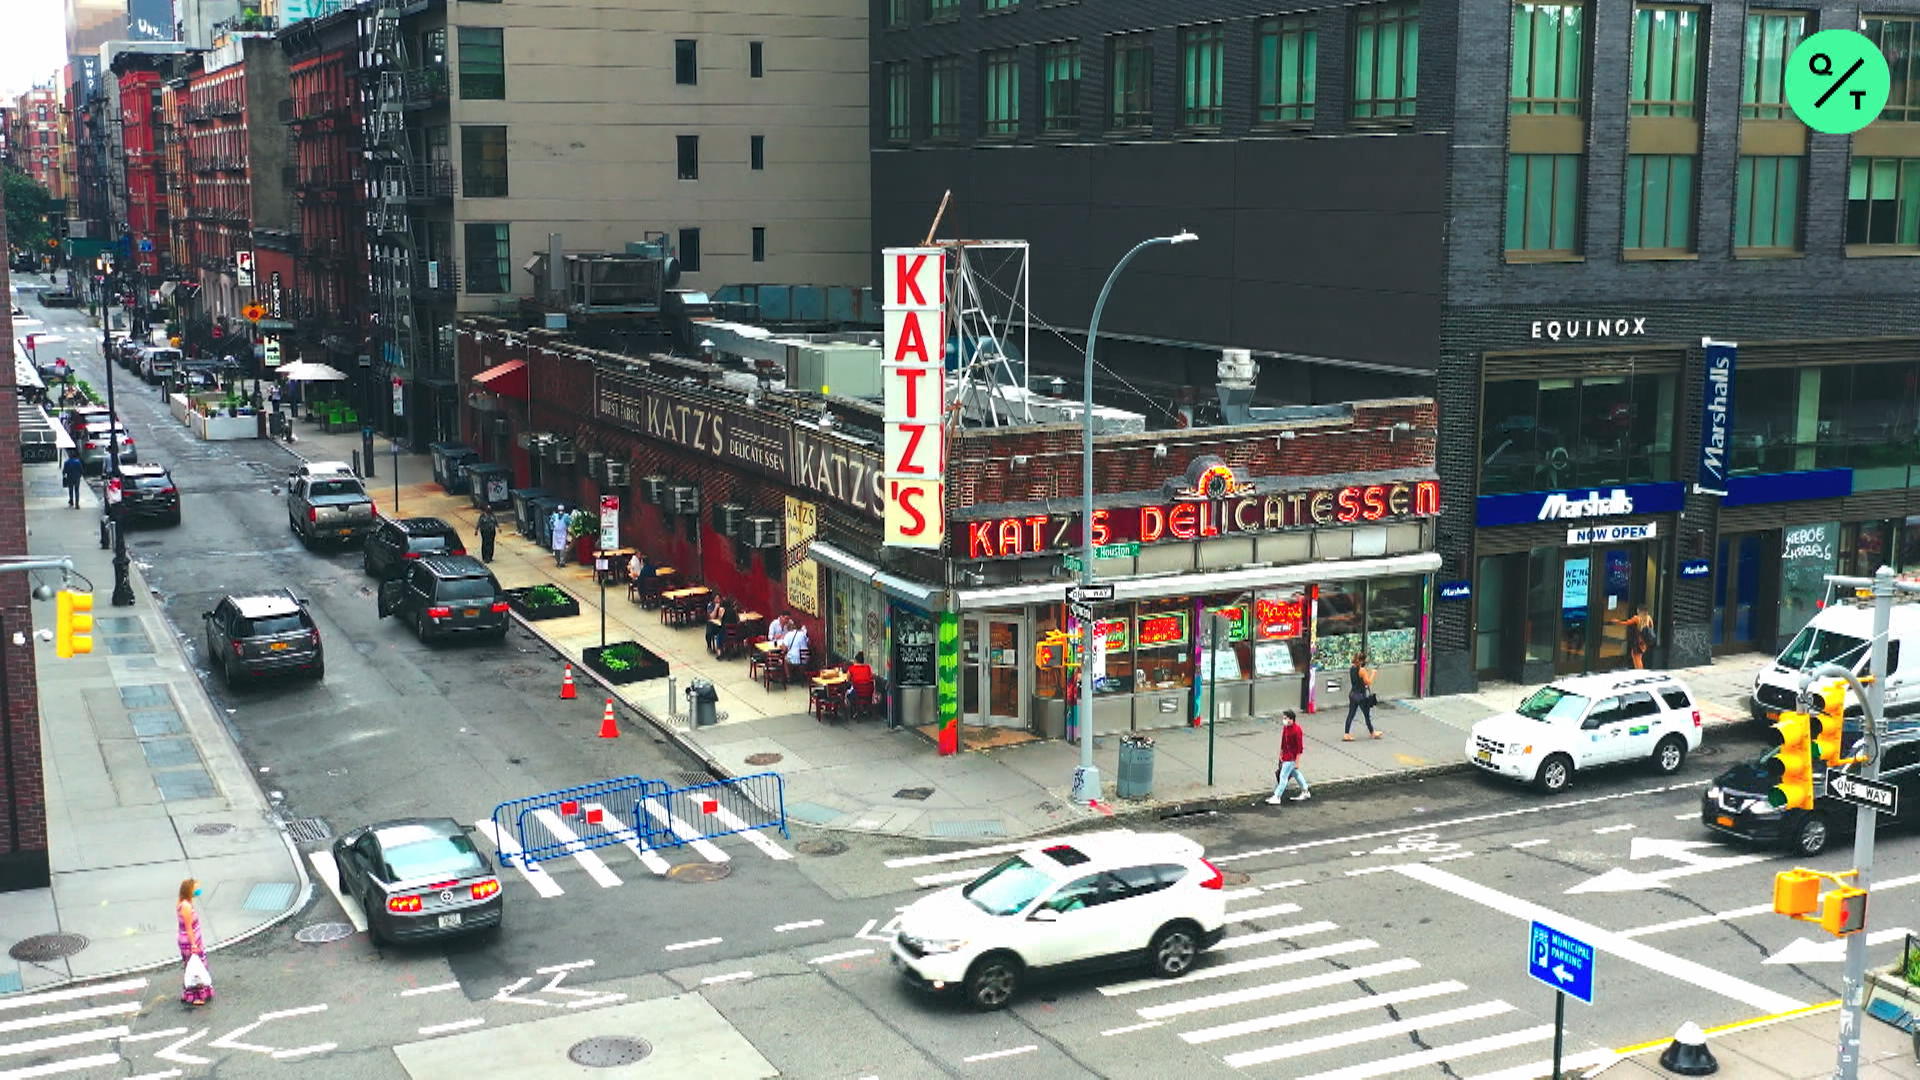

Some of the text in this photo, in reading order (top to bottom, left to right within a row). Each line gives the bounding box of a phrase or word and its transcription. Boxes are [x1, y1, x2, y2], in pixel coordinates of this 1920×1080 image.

[1531, 317, 1647, 341] EQUINOX
[891, 254, 929, 536] KATZ'S
[647, 394, 723, 456] KATZ'S
[1704, 356, 1730, 480] Marshalls
[1139, 480, 1440, 542] DELICATESSEN
[1537, 489, 1634, 520] Marshalls
[1576, 527, 1648, 541] NOW OPEN
[1100, 546, 1131, 557] Houston
[1837, 779, 1888, 802] ONE WAY
[1551, 933, 1591, 961] MUNICIPAL
[1551, 946, 1582, 970] PARKING
